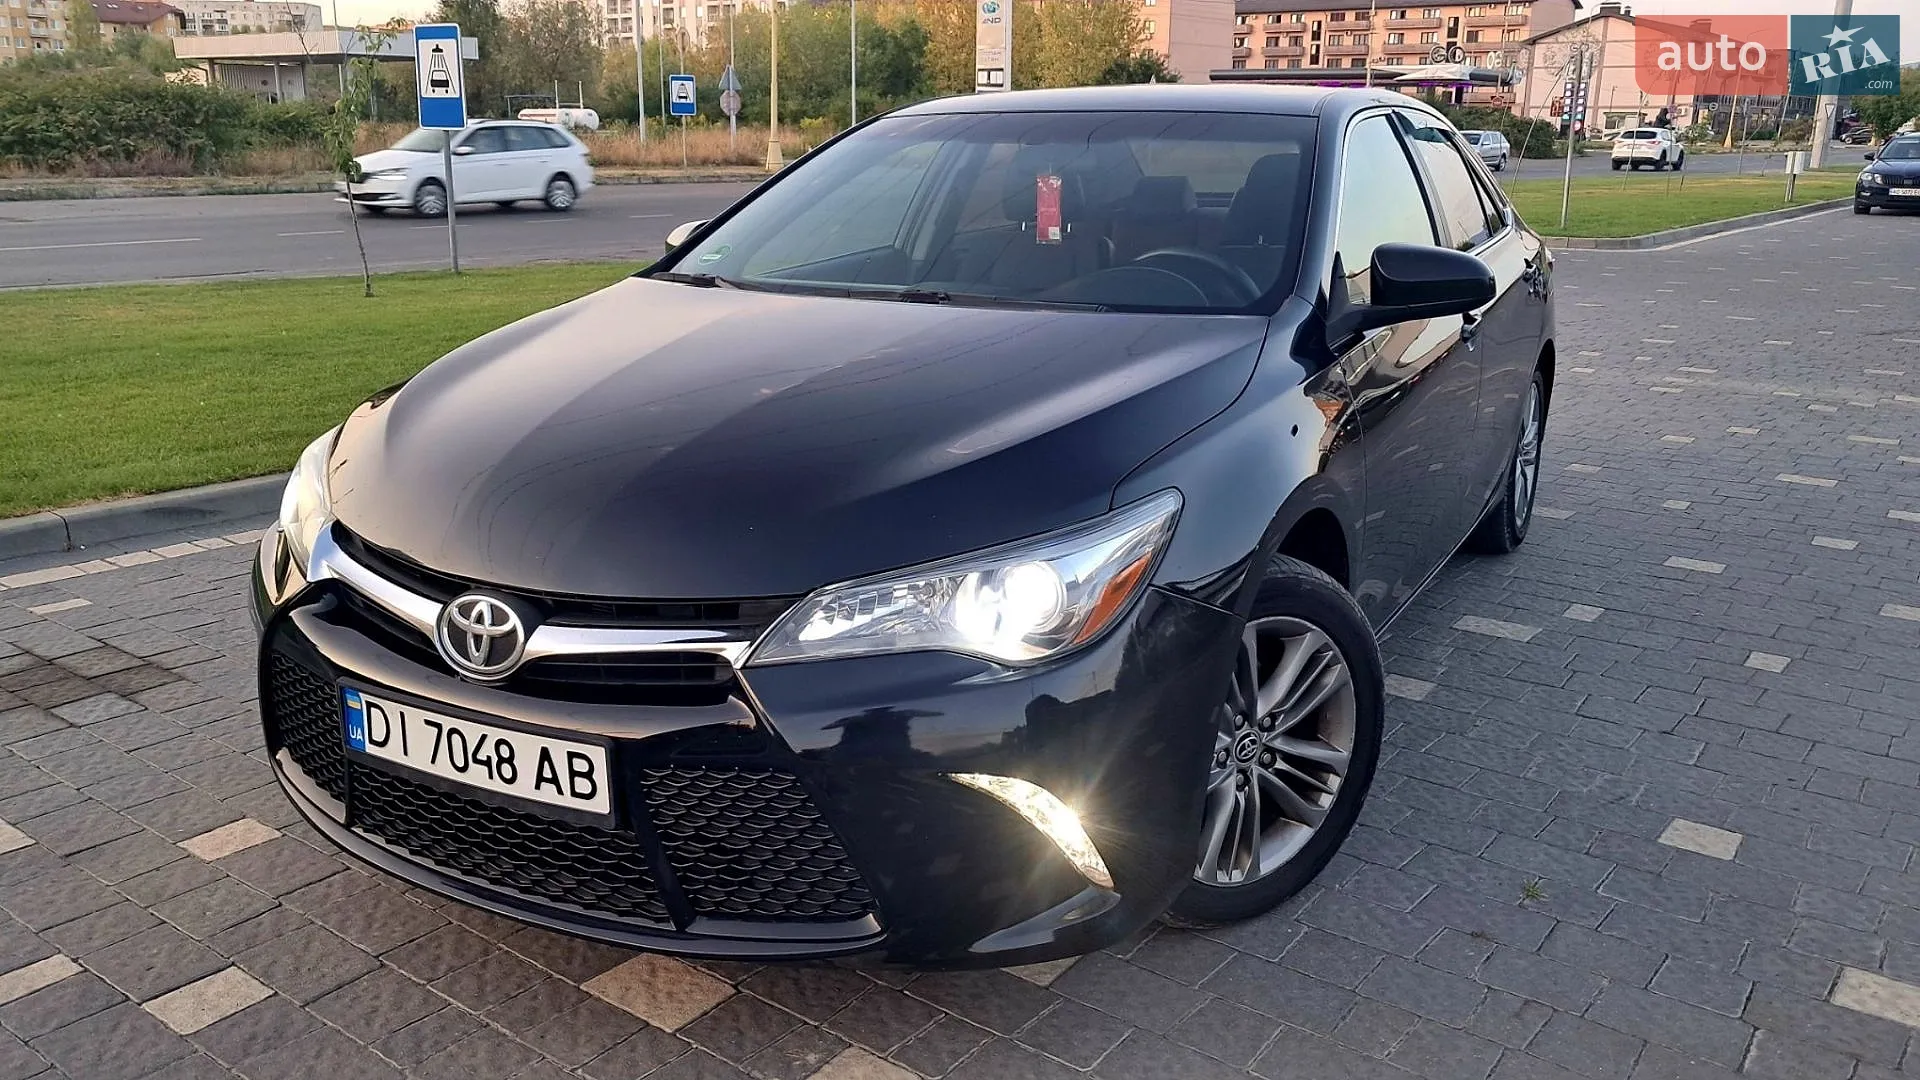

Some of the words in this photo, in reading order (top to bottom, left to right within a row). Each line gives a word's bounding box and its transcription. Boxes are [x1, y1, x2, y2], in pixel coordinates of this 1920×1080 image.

[350, 726, 363, 742] UA
[365, 700, 408, 756] DI
[423, 719, 518, 785] 7048
[534, 746, 597, 800] AB
